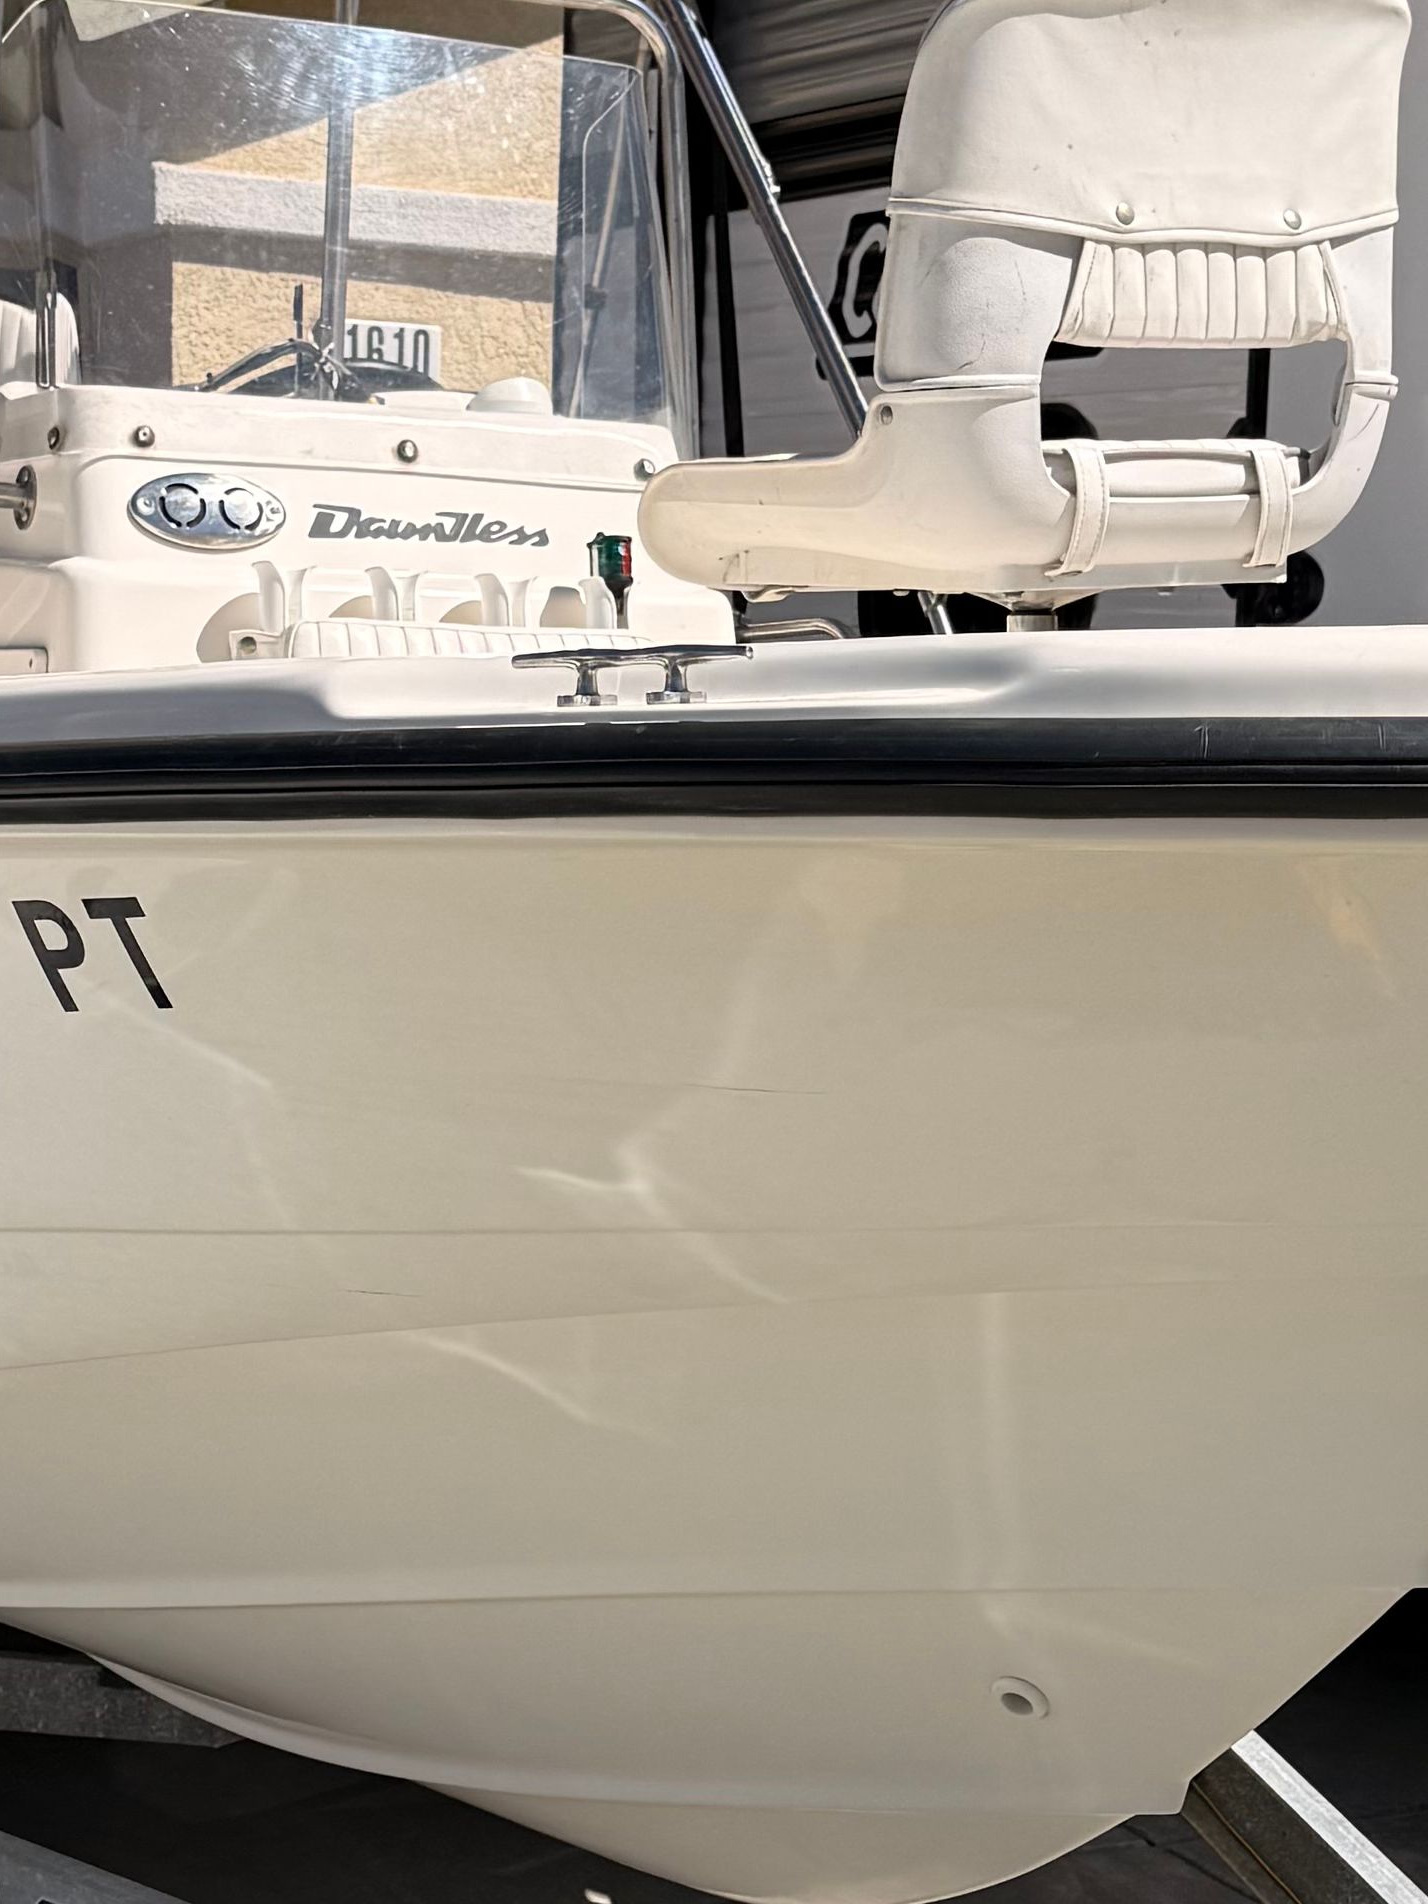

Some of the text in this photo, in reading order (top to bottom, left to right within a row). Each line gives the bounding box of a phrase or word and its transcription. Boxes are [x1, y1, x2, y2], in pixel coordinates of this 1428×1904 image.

[347, 324, 430, 376] 1610
[308, 503, 550, 547] Dauntless
[12, 896, 174, 1013] PT
